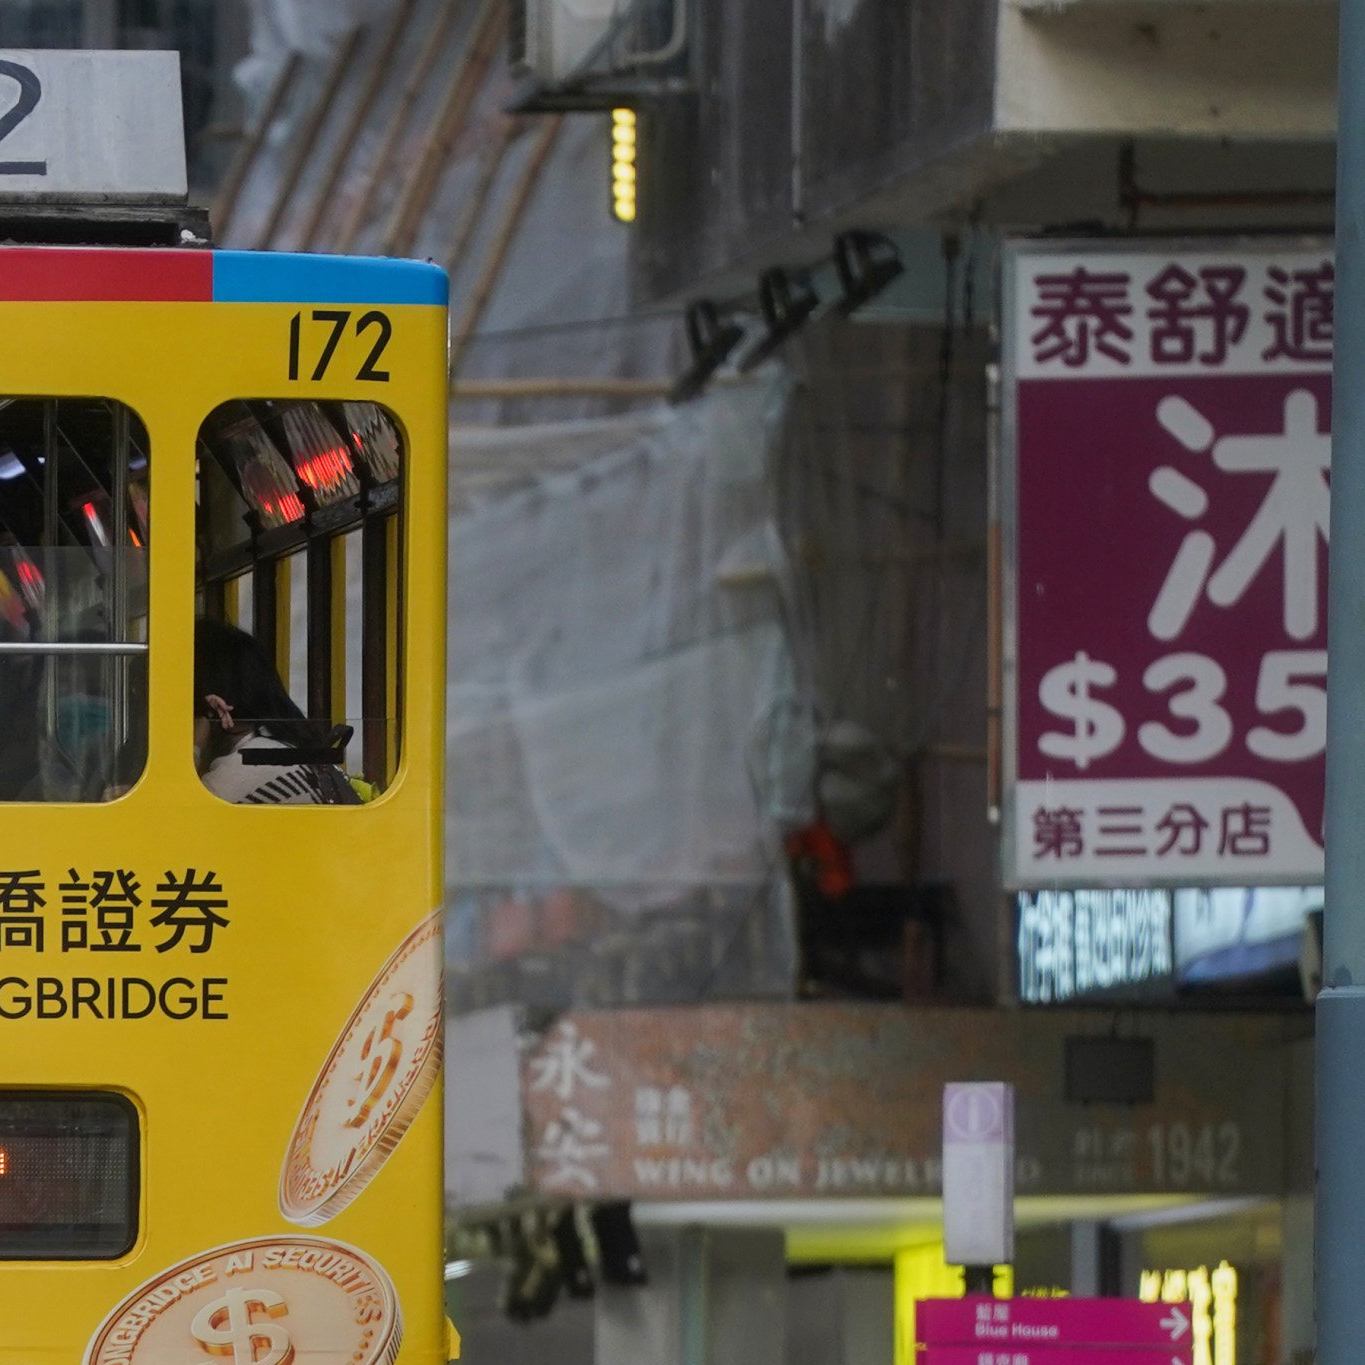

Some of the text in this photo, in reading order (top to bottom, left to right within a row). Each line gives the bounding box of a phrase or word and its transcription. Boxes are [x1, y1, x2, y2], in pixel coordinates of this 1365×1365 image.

[1031, 262, 1335, 367] 泰舒適
[287, 309, 392, 383] 172
[1032, 803, 1272, 861] 第三分店
[528, 1018, 611, 1192] 永安
[632, 1157, 734, 1190] WING
[747, 1157, 801, 1190] ON
[1148, 1120, 1240, 1184] 1942
[224, 1251, 255, 1277] AI
[975, 1323, 1059, 1338] Blue House
